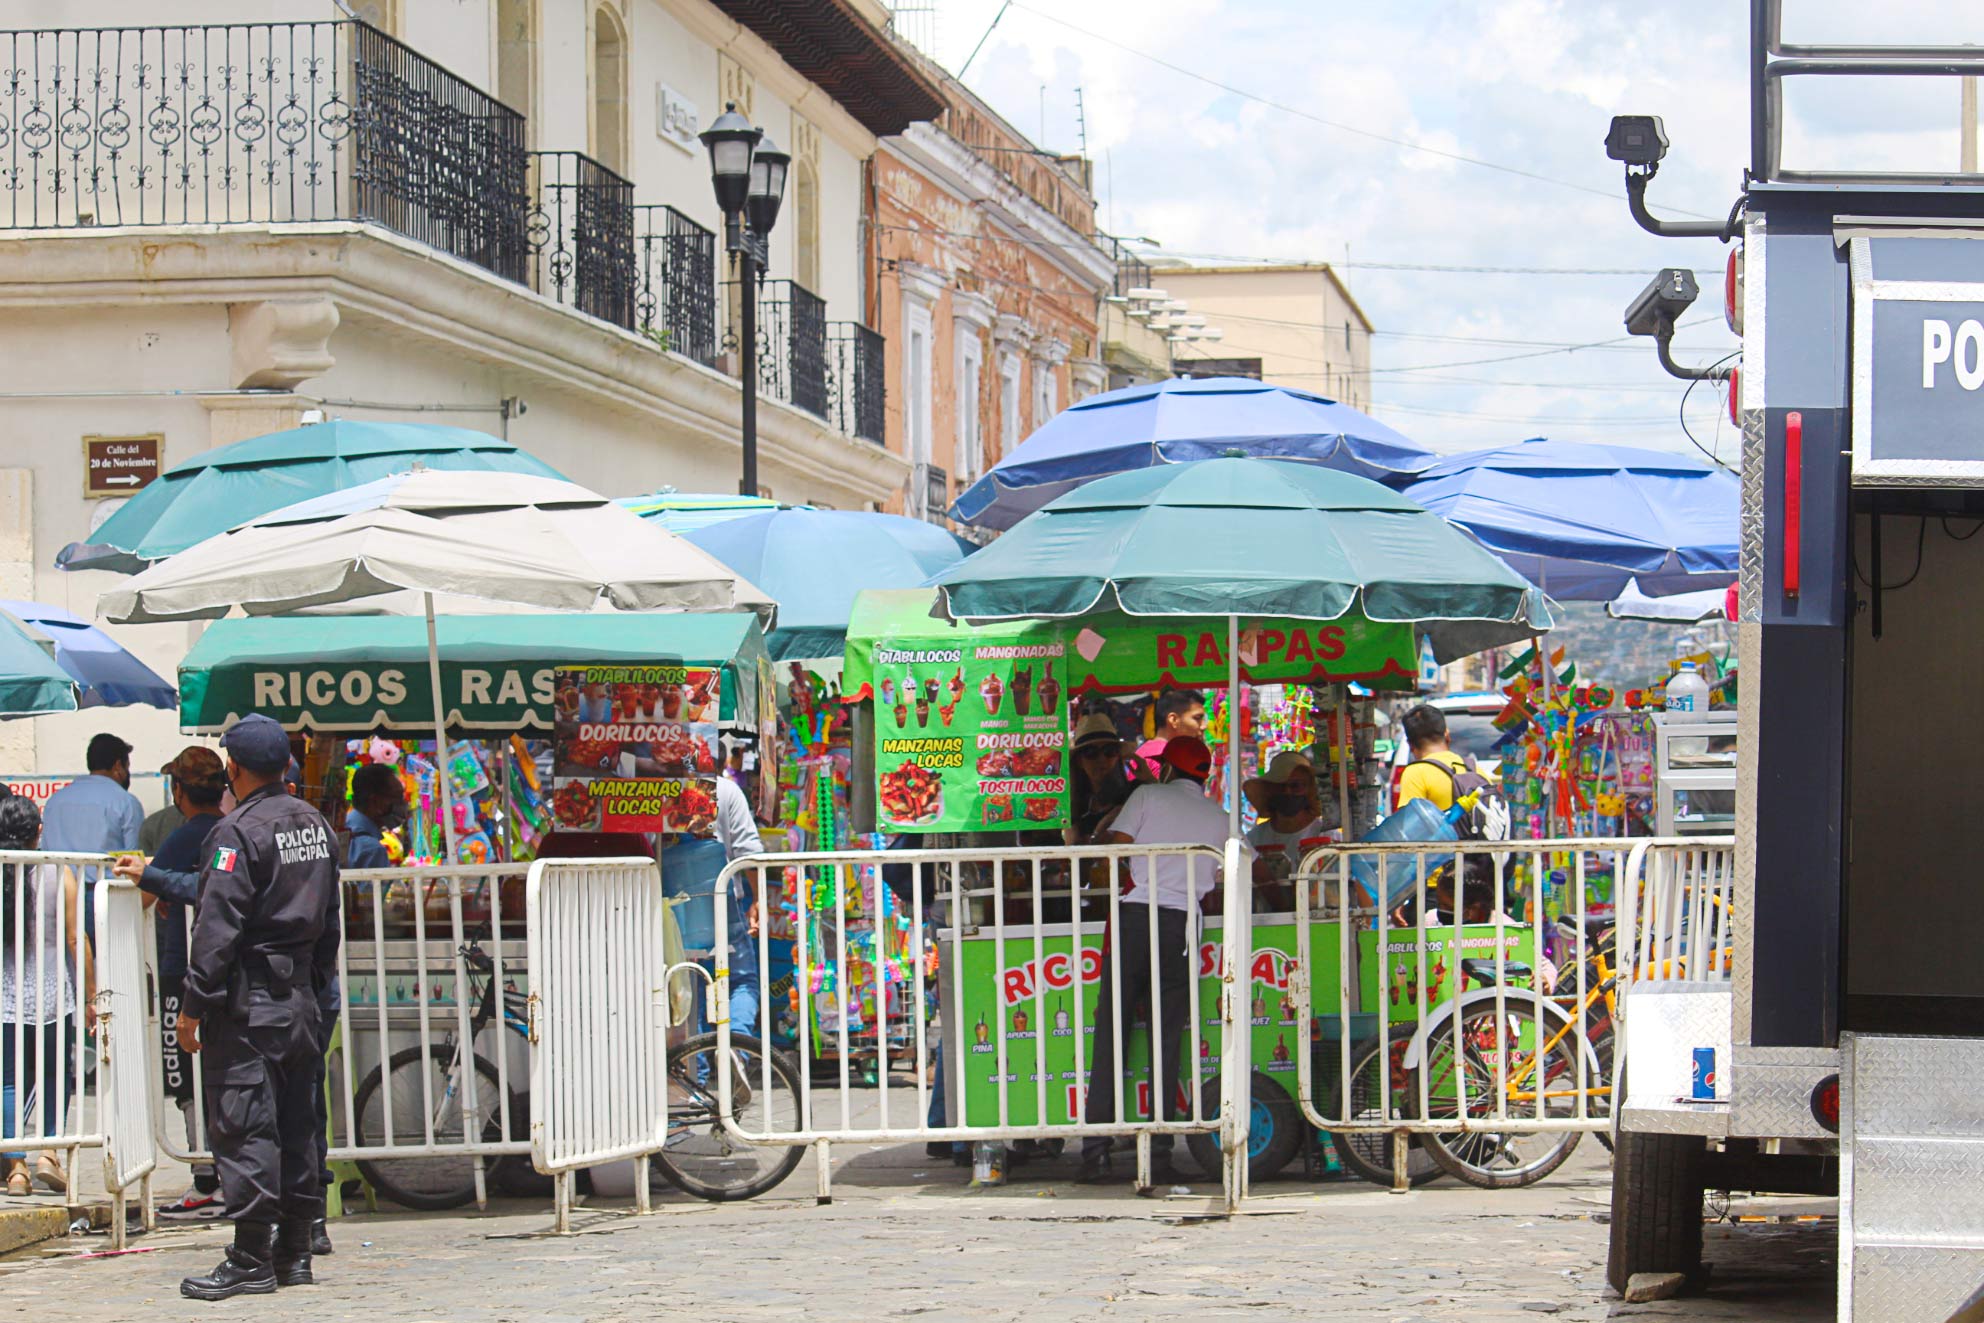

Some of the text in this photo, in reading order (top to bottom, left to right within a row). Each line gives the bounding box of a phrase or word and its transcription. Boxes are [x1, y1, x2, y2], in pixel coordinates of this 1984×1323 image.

[106, 445, 139, 454] Calle del
[90, 457, 156, 468] 20 de Noviembre
[975, 645, 1064, 659] MANGONADAS
[1156, 626, 1346, 668] RAPAS
[879, 649, 961, 664] DIABLILOCOS
[587, 669, 687, 684] DIABLILOCOS
[254, 670, 407, 707] RICOS
[579, 723, 682, 742] DORILOCOS
[976, 732, 1064, 749] DORILOCOS
[883, 738, 963, 753] MANZANAS
[917, 754, 963, 767] LOCAS
[589, 780, 682, 797] MANZANAS
[978, 778, 1065, 794] TOSTILOCOS
[608, 799, 662, 815] LOCAS
[275, 824, 328, 849] POLICÍA
[280, 844, 330, 864] MUNICIPAL
[1053, 1028, 1072, 1036] COCO
[163, 996, 182, 1087] adidas
